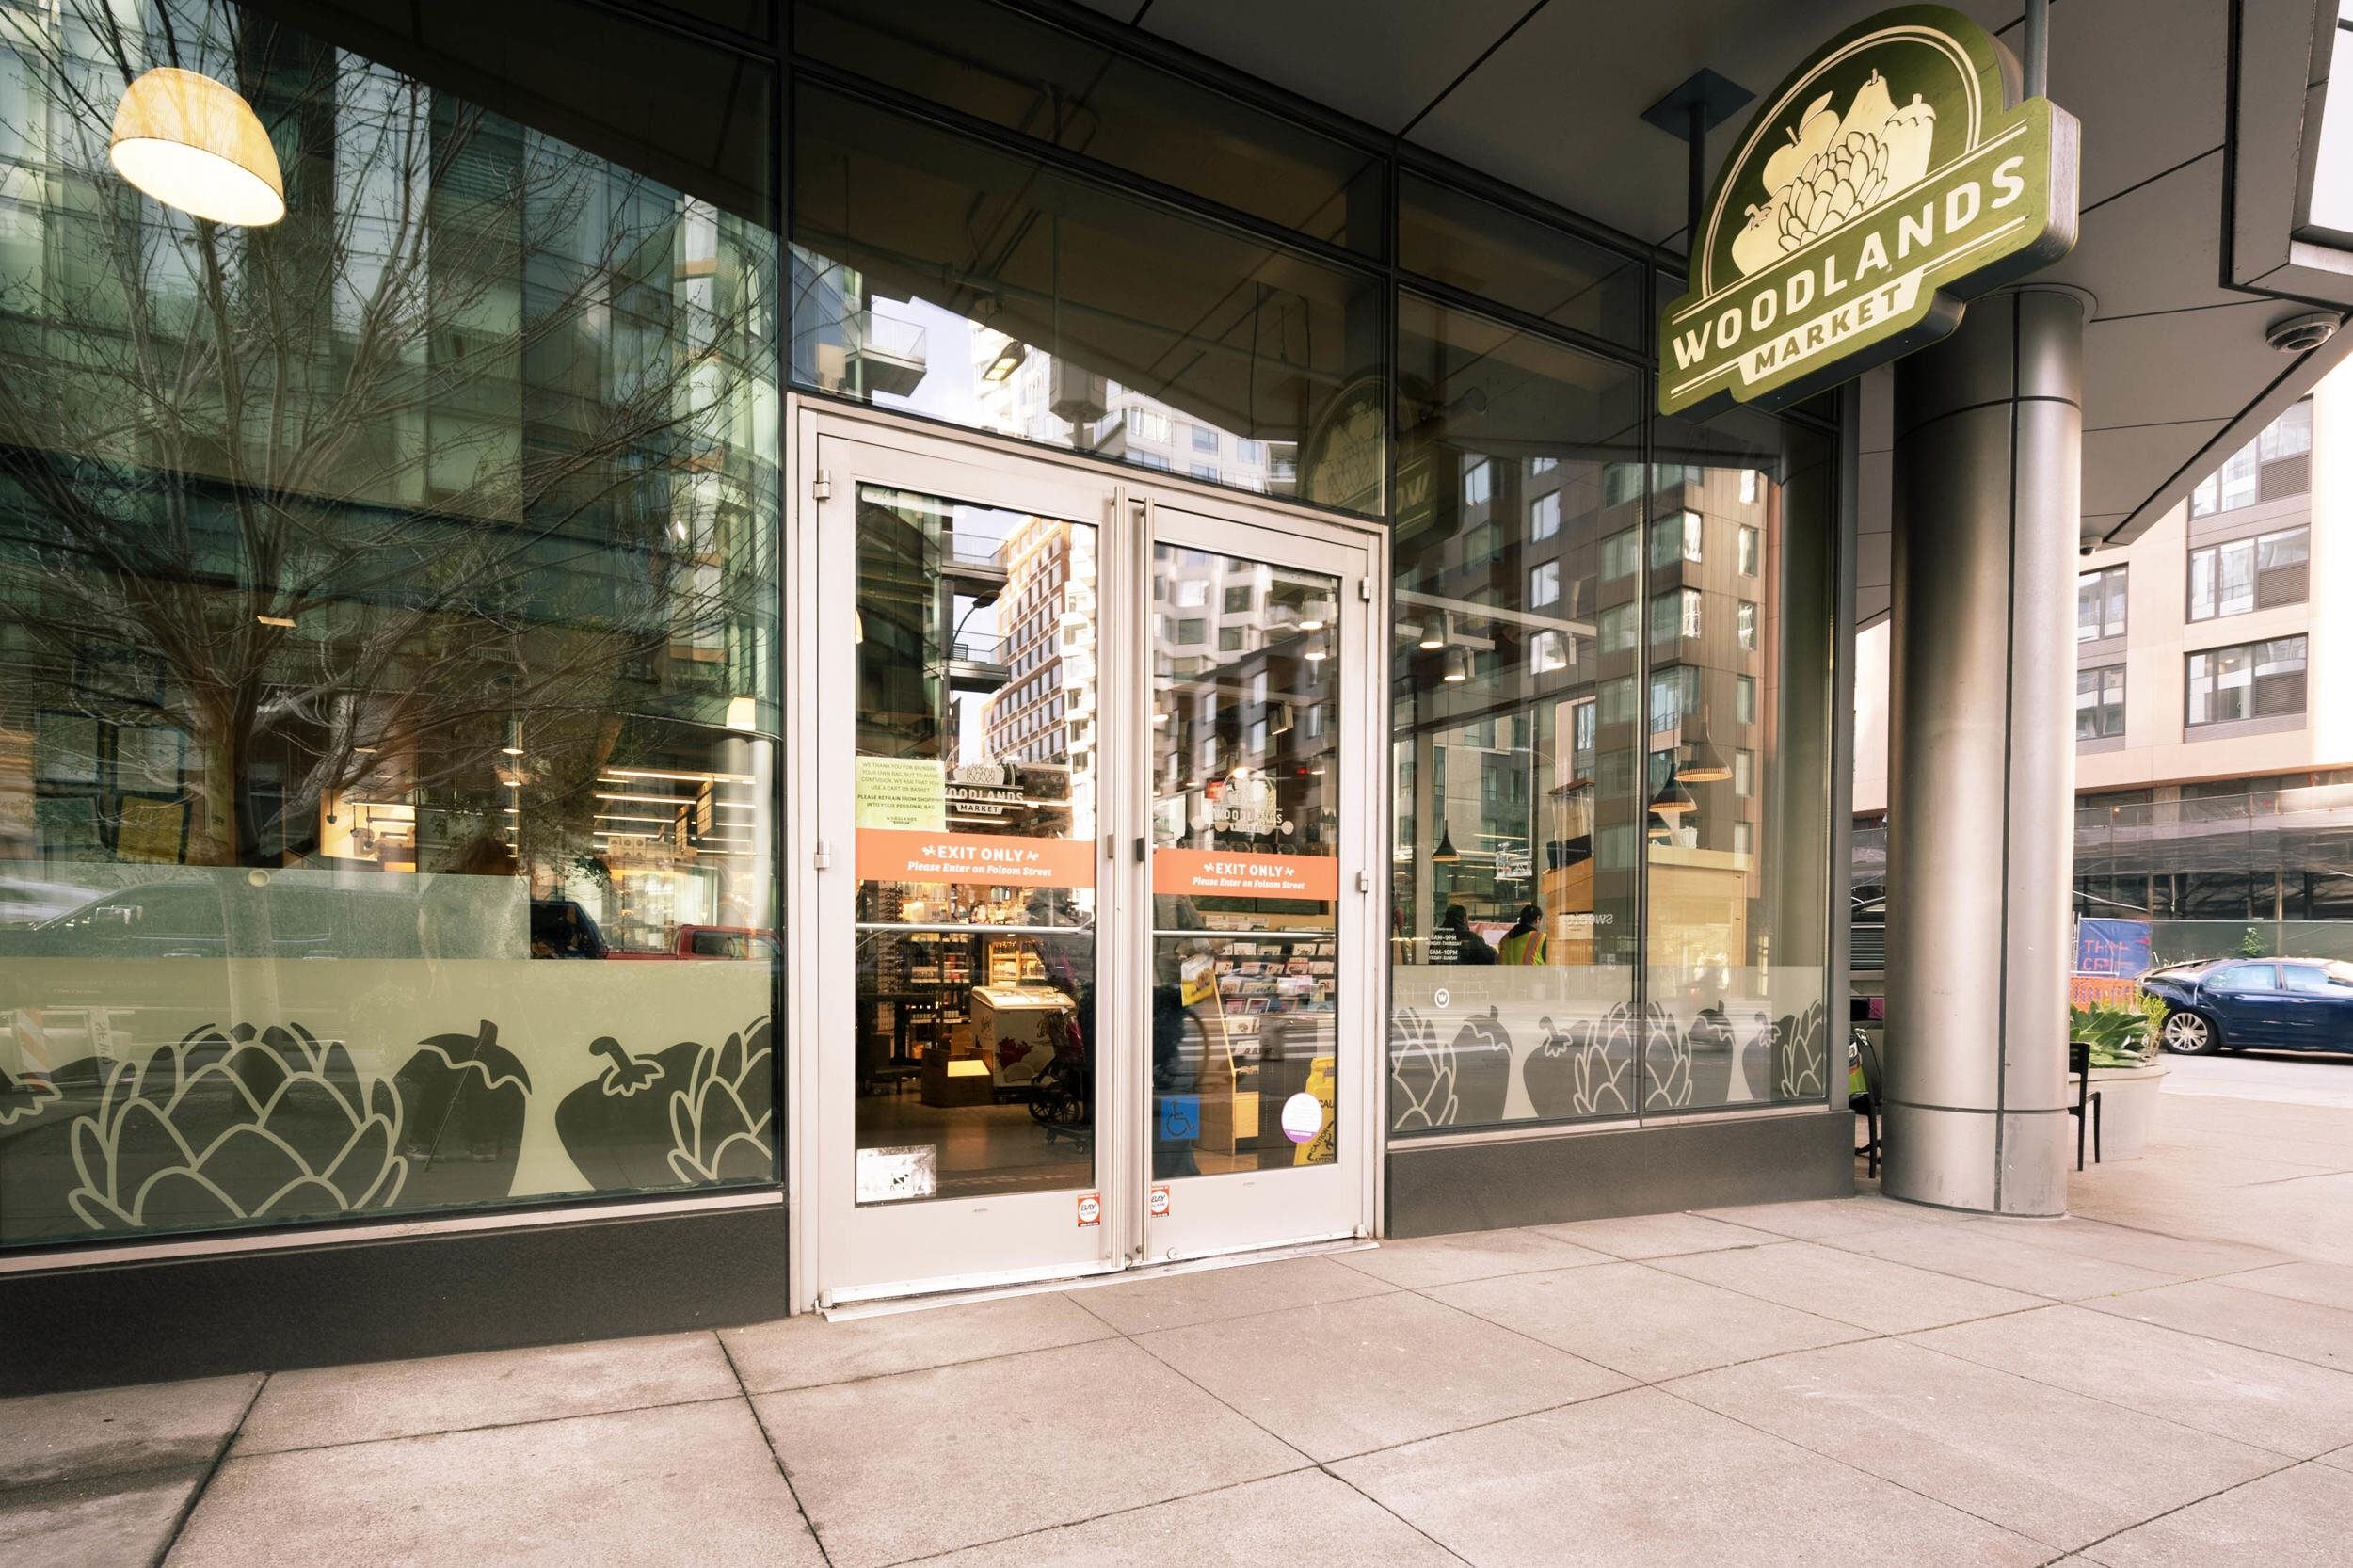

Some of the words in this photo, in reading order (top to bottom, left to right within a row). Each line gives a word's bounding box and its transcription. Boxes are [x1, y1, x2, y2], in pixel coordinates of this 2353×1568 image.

[1672, 155, 2025, 371] WOODLANDS
[1753, 282, 1903, 376] MARKET
[960, 804, 1000, 813] MARKET
[937, 845, 977, 860] EXIT
[980, 847, 1024, 862] ONLY
[907, 860, 941, 872] Please
[942, 863, 971, 873] Enter
[972, 865, 984, 873] on
[986, 865, 1021, 875] Folsom
[1022, 867, 1052, 876] Street
[1215, 862, 1247, 875] EXIT
[1249, 864, 1284, 877] ONLY
[1193, 876, 1219, 886] Please
[1220, 878, 1241, 887] Enter
[1254, 879, 1280, 888] Folsom
[1281, 881, 1305, 889] Street
[1310, 1128, 1329, 1154] CAUTION
[1080, 1203, 1096, 1211] BAY
